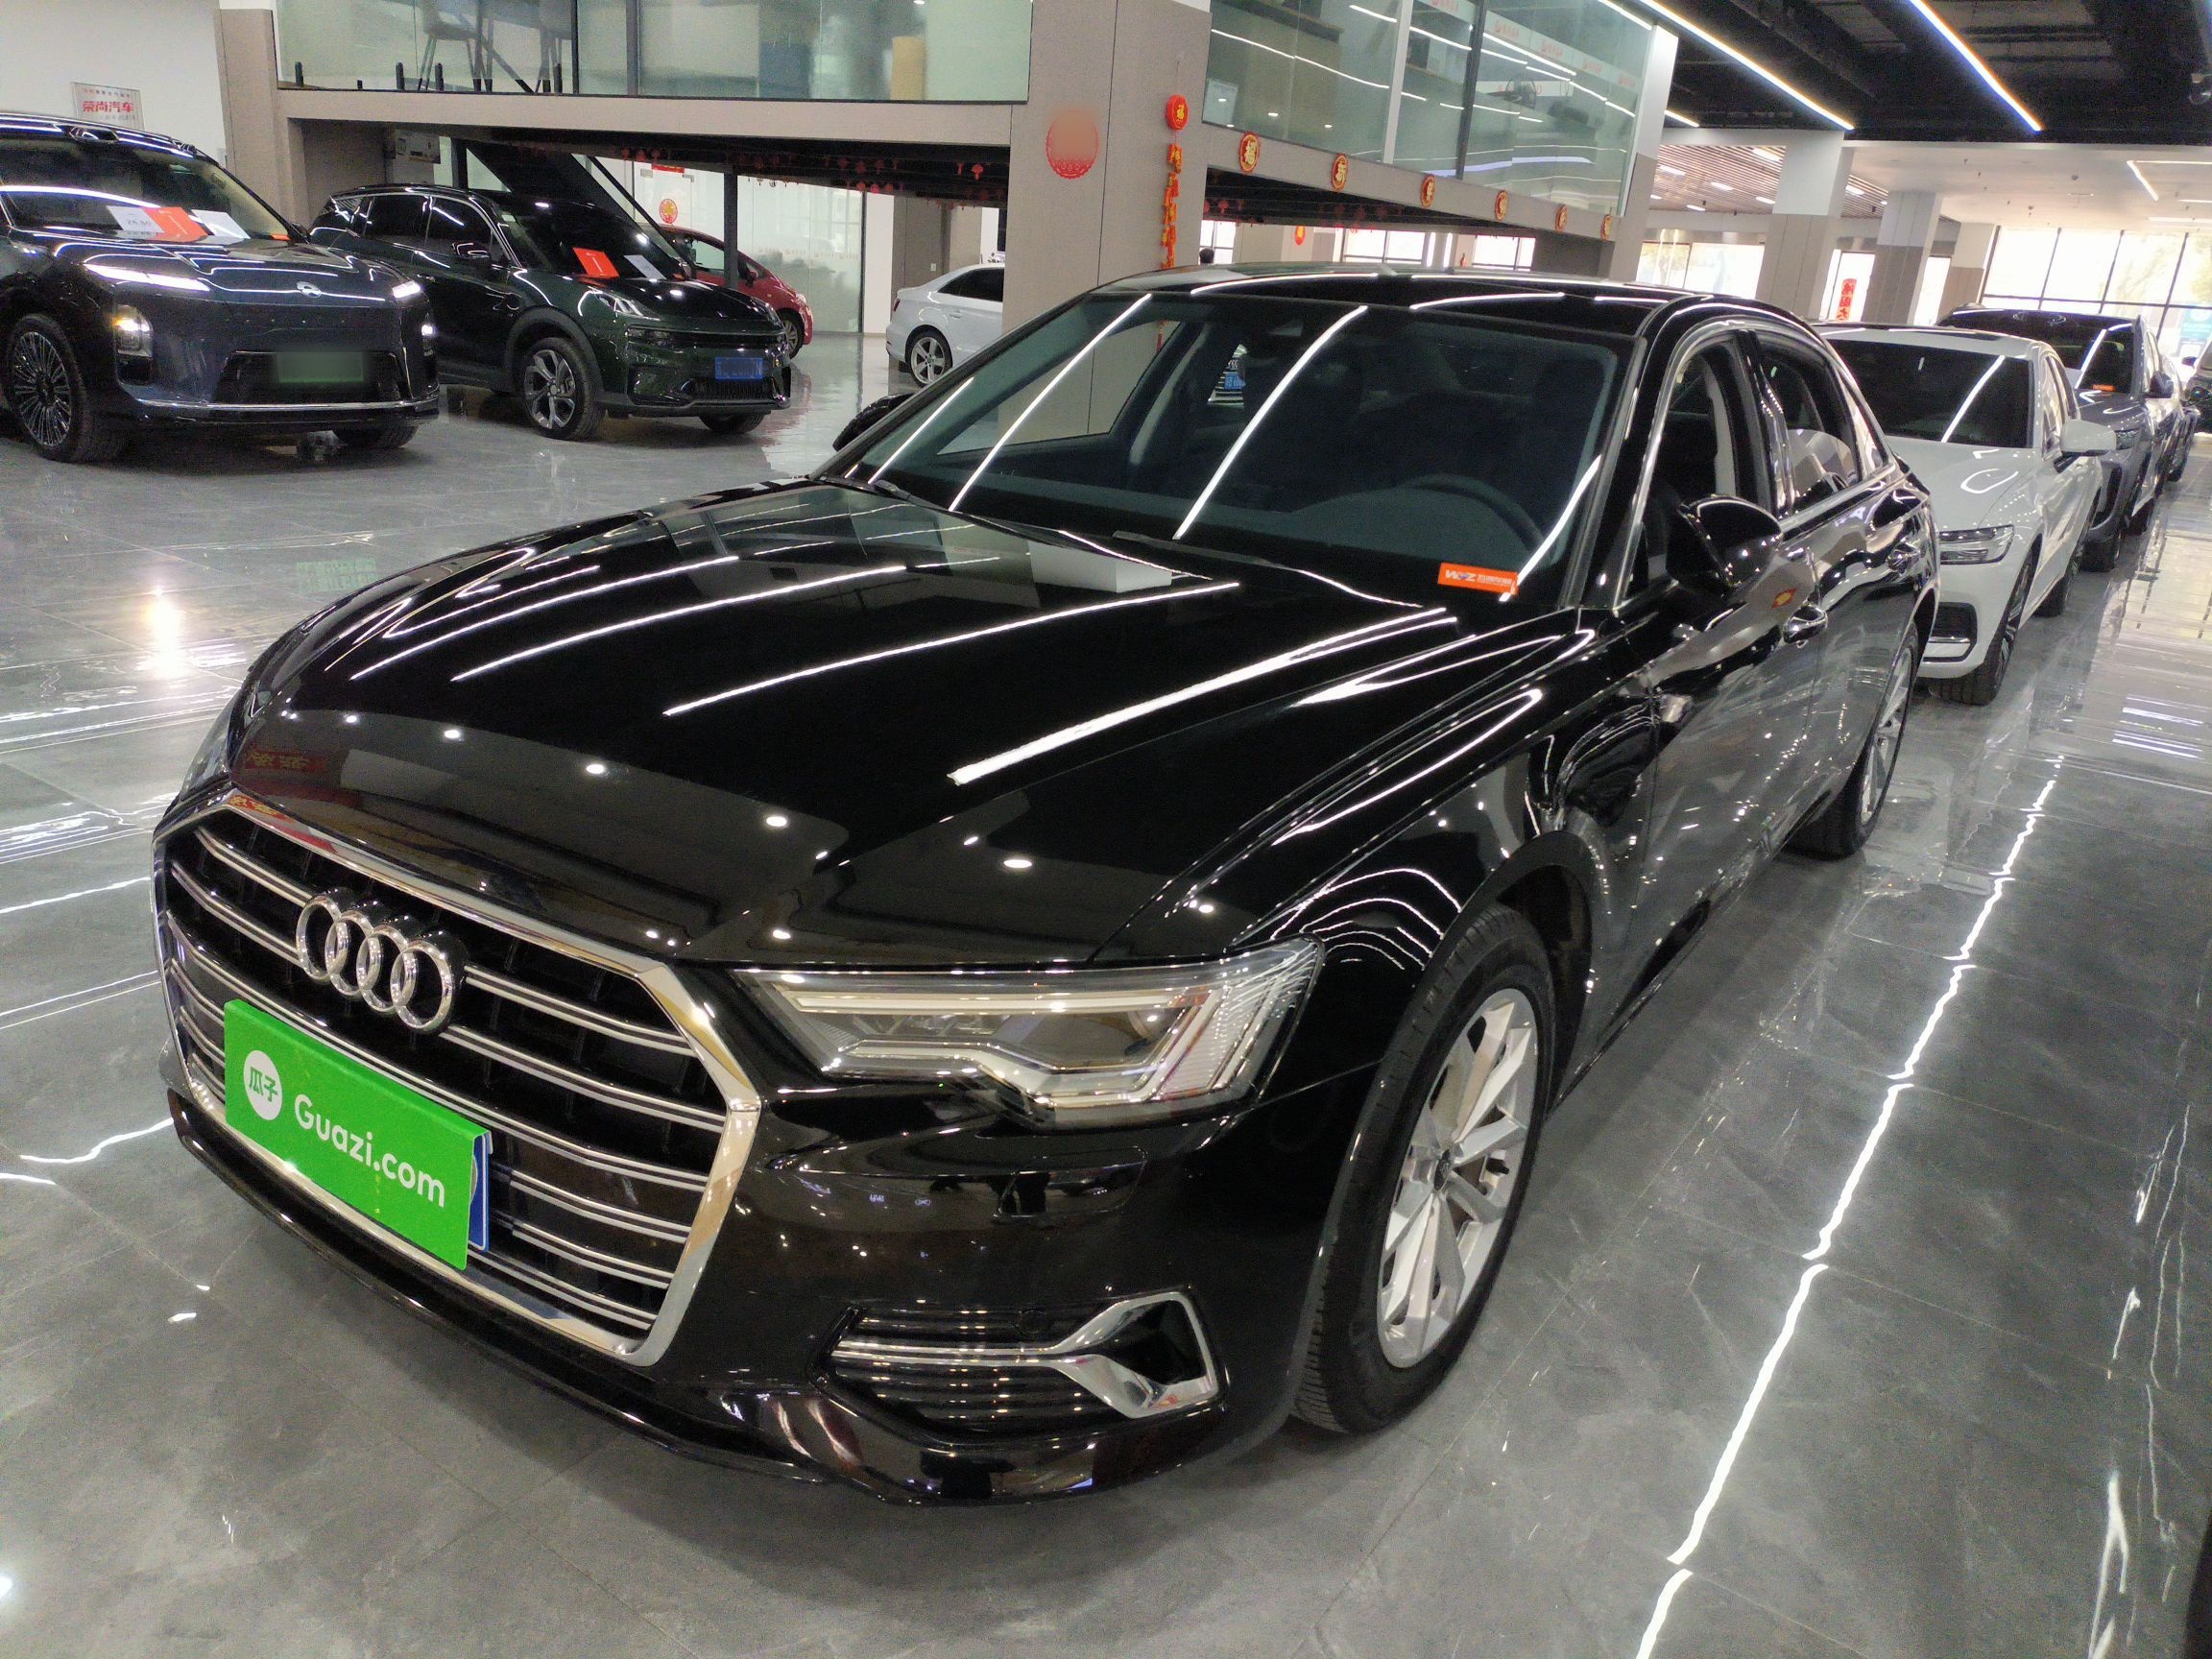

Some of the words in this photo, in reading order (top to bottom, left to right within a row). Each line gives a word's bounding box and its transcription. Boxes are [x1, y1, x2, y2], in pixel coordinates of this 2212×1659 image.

[83, 100, 134, 112] 荣尚汽车
[249, 1066, 278, 1103] 瓜子
[294, 1094, 445, 1209] Guazi.com
